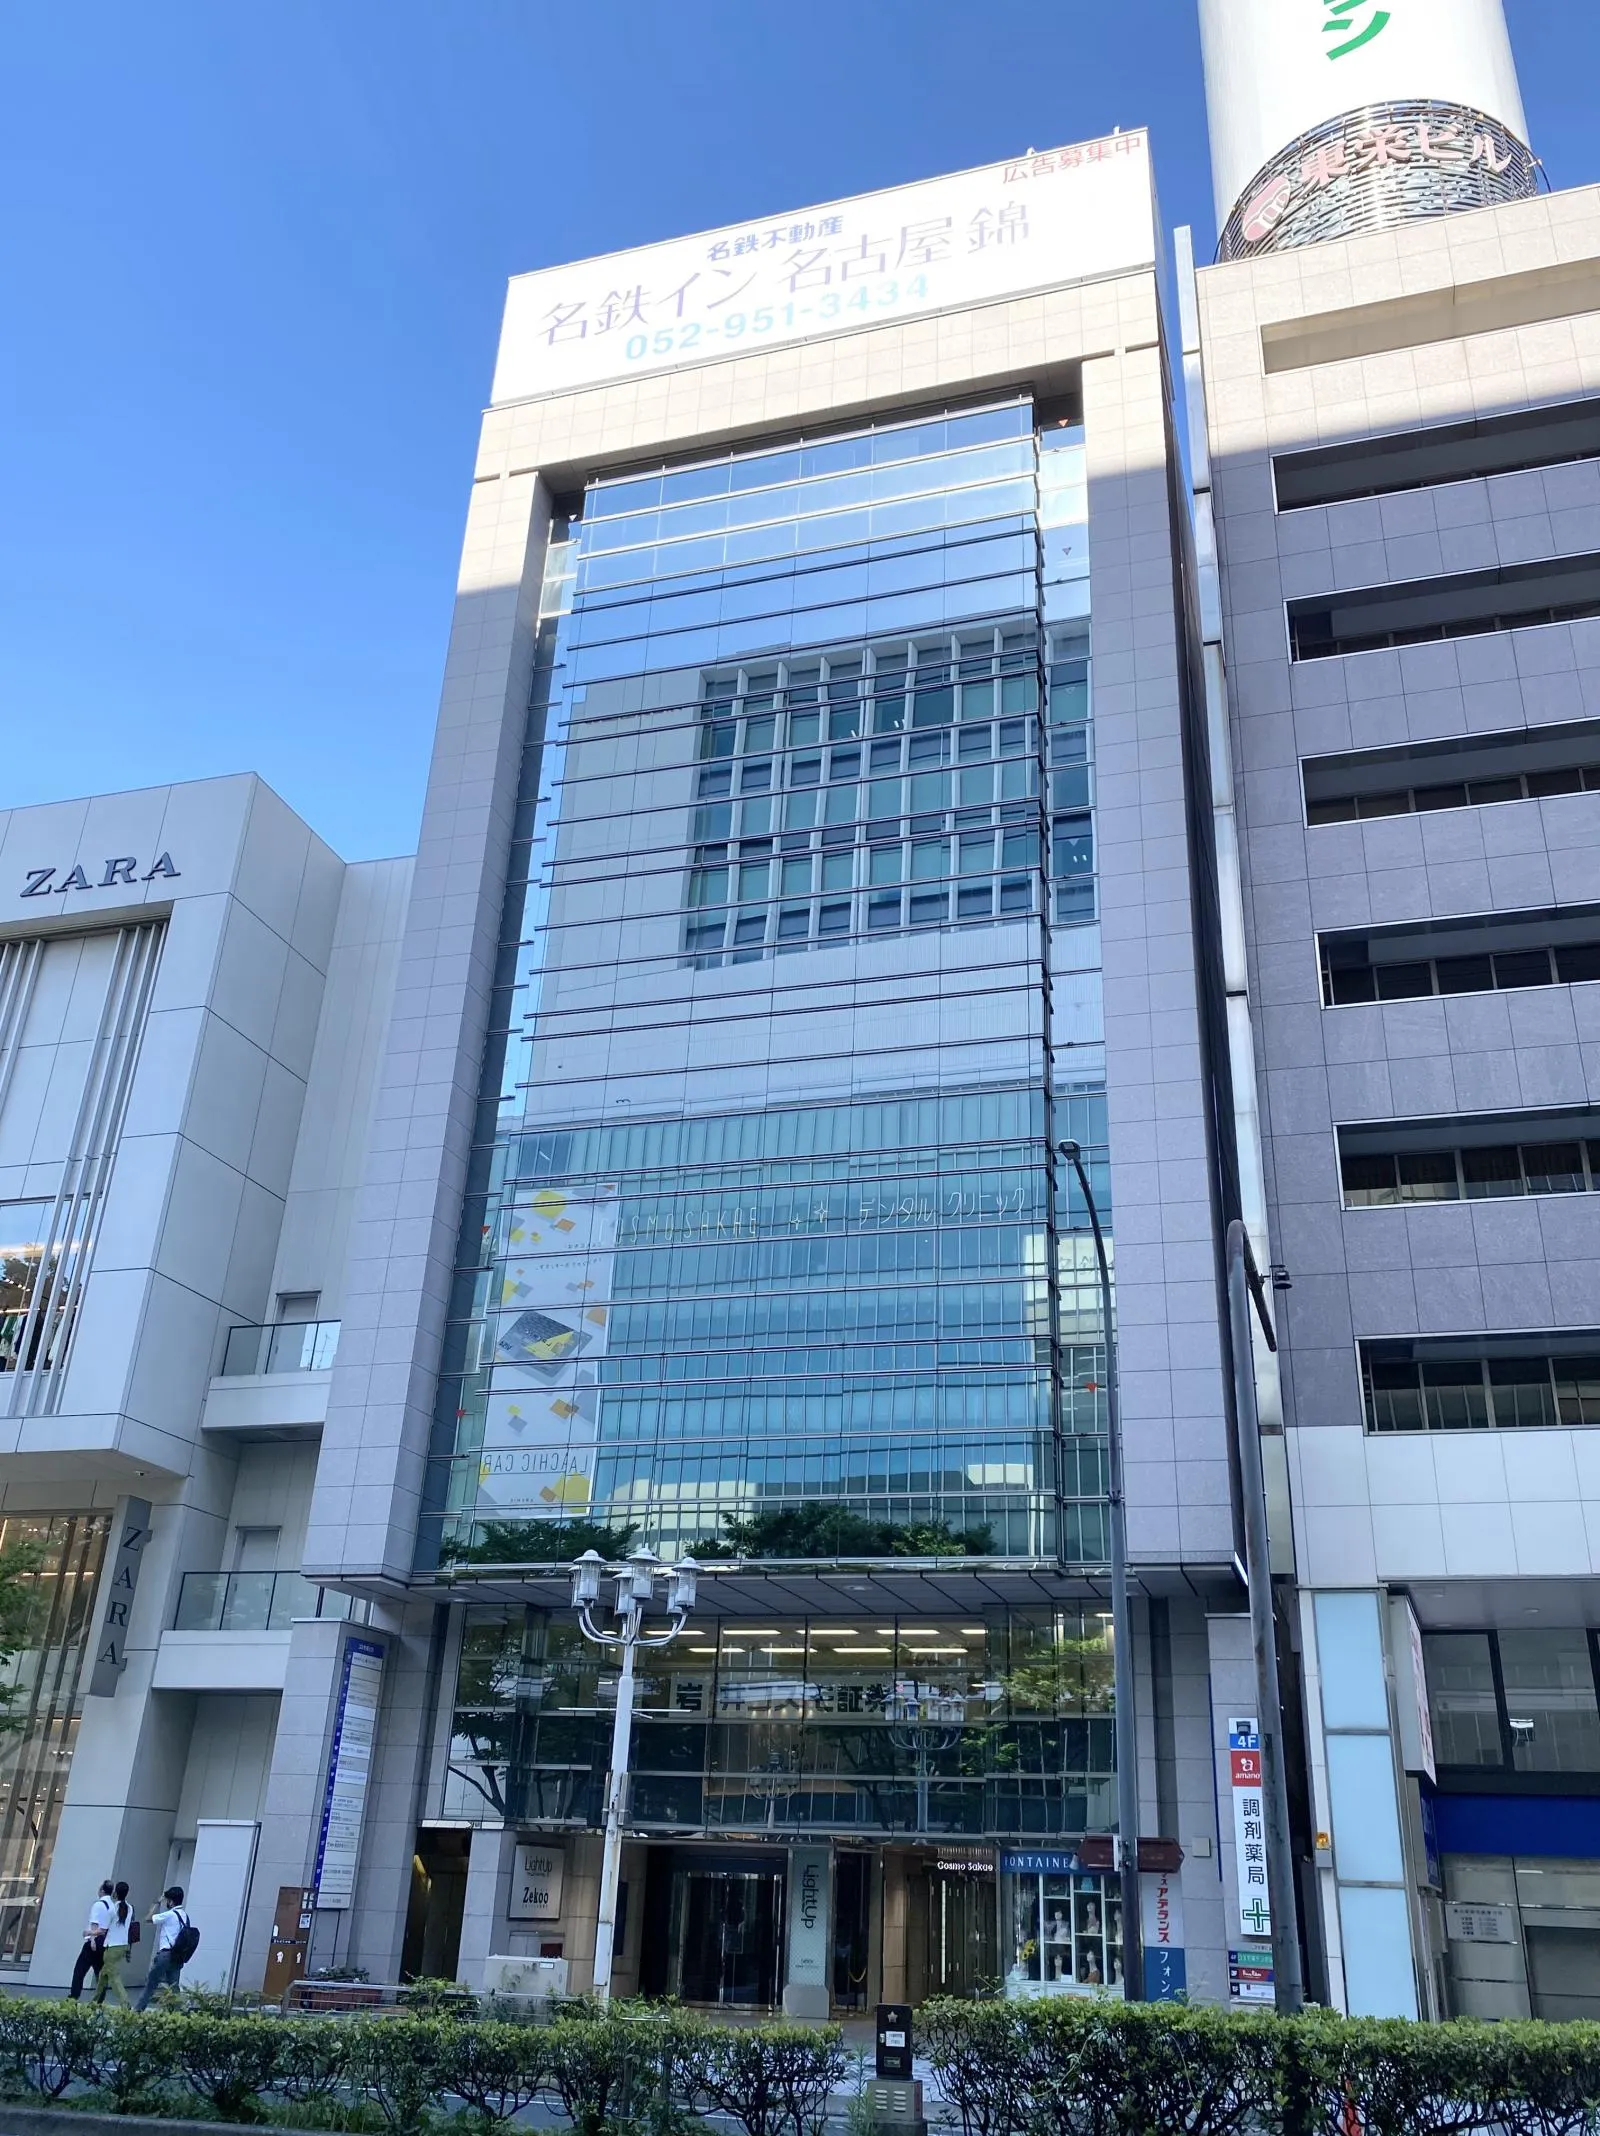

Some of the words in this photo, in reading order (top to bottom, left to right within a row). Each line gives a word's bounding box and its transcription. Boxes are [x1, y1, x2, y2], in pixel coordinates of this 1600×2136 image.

[1002, 135, 1141, 184] 広告募集中
[1300, 122, 1512, 192] 東栄ビル
[706, 215, 844, 262] 名鉄不動産
[624, 273, 929, 361] 052-951-3434
[20, 851, 182, 898] ZARA
[97, 1526, 143, 1665] ZARA
[1237, 1735, 1257, 1748] 4F
[1242, 1798, 1265, 1885] 調剤薬局
[937, 1861, 966, 1870] Cosmo
[967, 1862, 994, 1872] Sakae
